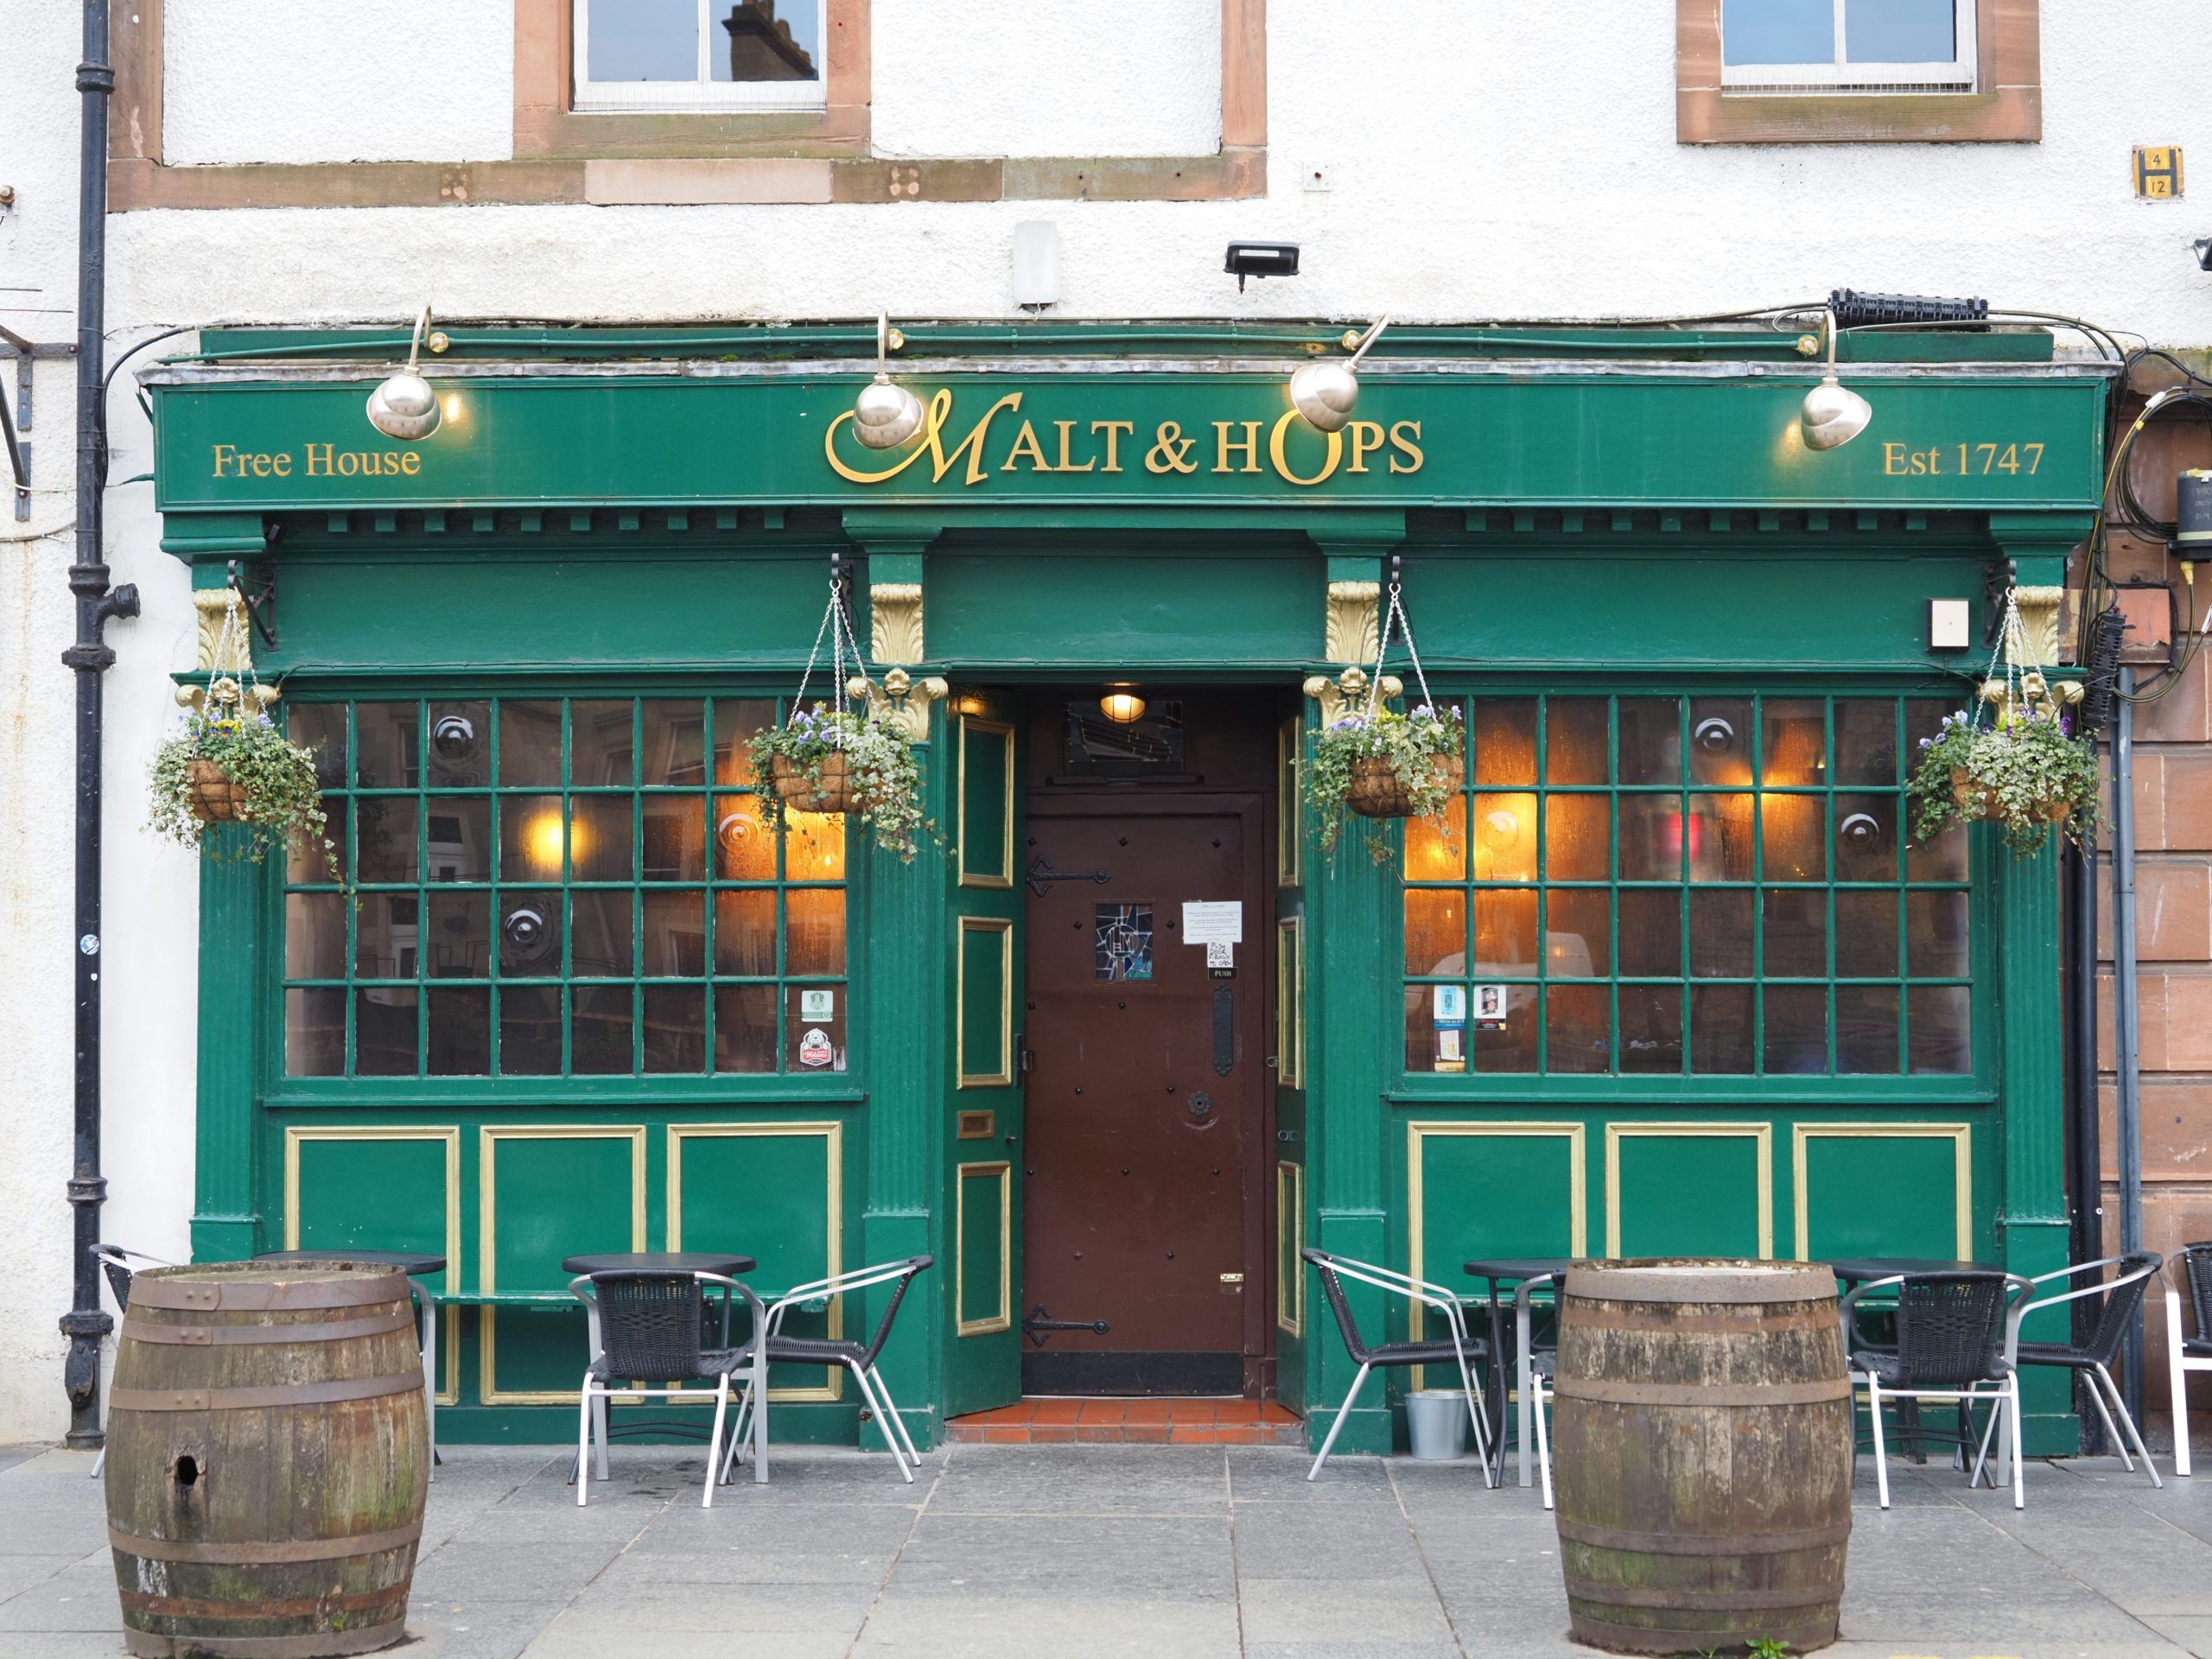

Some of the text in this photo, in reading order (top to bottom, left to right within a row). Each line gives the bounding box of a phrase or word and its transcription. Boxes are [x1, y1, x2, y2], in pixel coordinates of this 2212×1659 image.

[2139, 149, 2177, 196] H
[2152, 154, 2161, 165] 4
[2152, 181, 2166, 193] 12
[212, 443, 422, 477] Free House
[1145, 421, 1198, 474] &
[1211, 408, 1424, 486] HOPS
[1883, 442, 2046, 476] Est 1747
